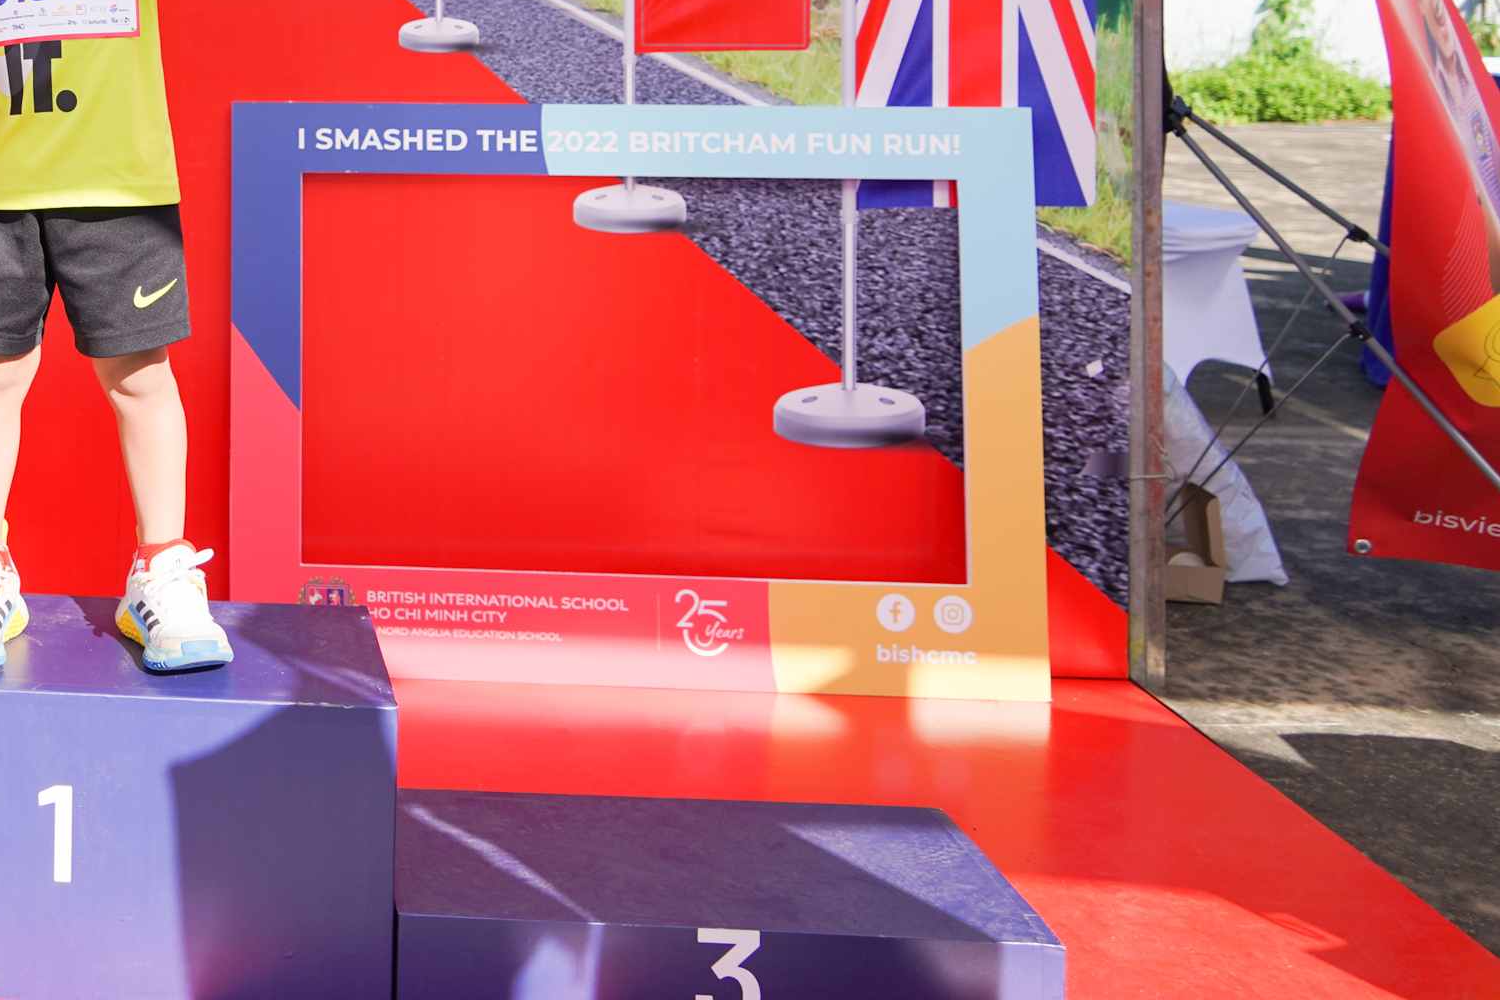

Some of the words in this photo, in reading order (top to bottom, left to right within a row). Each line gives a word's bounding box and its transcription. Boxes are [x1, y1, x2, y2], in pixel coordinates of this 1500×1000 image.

[298, 127, 305, 149] I
[315, 128, 468, 151] SMASHED
[477, 129, 537, 152] THE
[546, 130, 619, 152] 2022
[628, 131, 796, 155] BRITCHAM
[807, 132, 871, 155] FUN
[884, 133, 962, 156] RUN!
[366, 590, 425, 605] BRITISH
[429, 593, 557, 609] INTERNATIONAL
[560, 597, 629, 611] SCHOOL
[394, 608, 421, 621] CHI
[424, 609, 468, 622] MINH
[471, 610, 507, 623] CITY
[675, 589, 729, 656] 25
[695, 620, 744, 648] Years
[37, 786, 74, 884] 1
[695, 928, 761, 1000] 3
